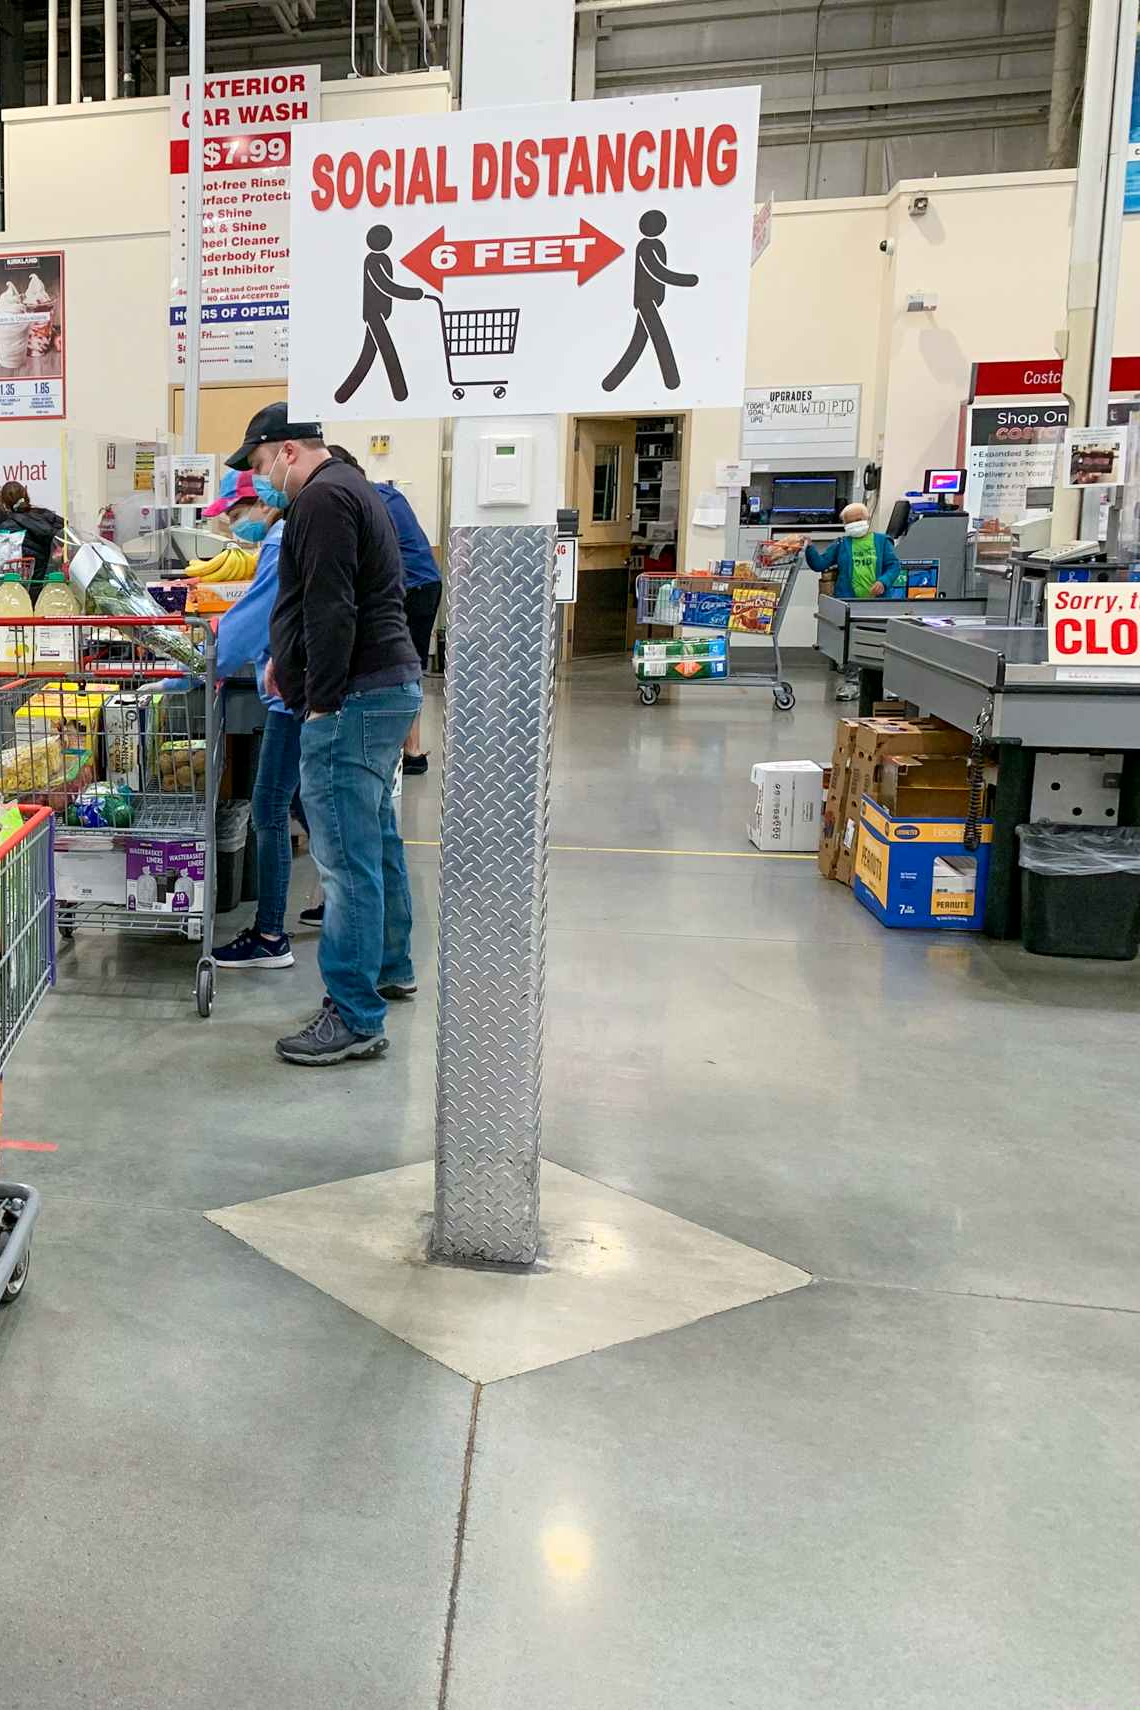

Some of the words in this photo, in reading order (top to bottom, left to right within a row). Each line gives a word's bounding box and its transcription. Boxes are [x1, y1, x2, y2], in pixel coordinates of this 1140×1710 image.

[186, 74, 305, 101] XTERIOR
[238, 101, 308, 124] WASH
[203, 137, 286, 168] $7.99
[310, 143, 459, 212] SOCIAL
[473, 123, 739, 202] DISTANCING
[203, 179, 247, 192] ot-free
[251, 178, 286, 188] Rinse
[203, 196, 238, 206] rface
[242, 191, 290, 203] Protect
[218, 208, 253, 218] Shine
[220, 224, 228, 233] &
[232, 222, 268, 232] Shine
[202, 238, 227, 249] heel
[231, 236, 280, 247] Cleaner
[203, 251, 256, 262] derbody
[431, 242, 458, 271] 6
[474, 237, 598, 267] FEET
[222, 264, 275, 276] Inhibitor
[175, 310, 218, 321] HRS
[221, 308, 238, 318] OF
[0, 384, 16, 396] 1.35
[769, 390, 813, 402] UPGRADES
[997, 412, 1038, 426] Shop
[978, 450, 1022, 458] Expanded
[3, 460, 48, 481] what
[978, 471, 1012, 479] Delivery
[1054, 591, 1123, 614] Sorry,
[1130, 592, 1140, 609] t
[1055, 618, 1138, 655] CLO
[899, 904, 905, 914] 7
[936, 900, 970, 909] PEANUTS
